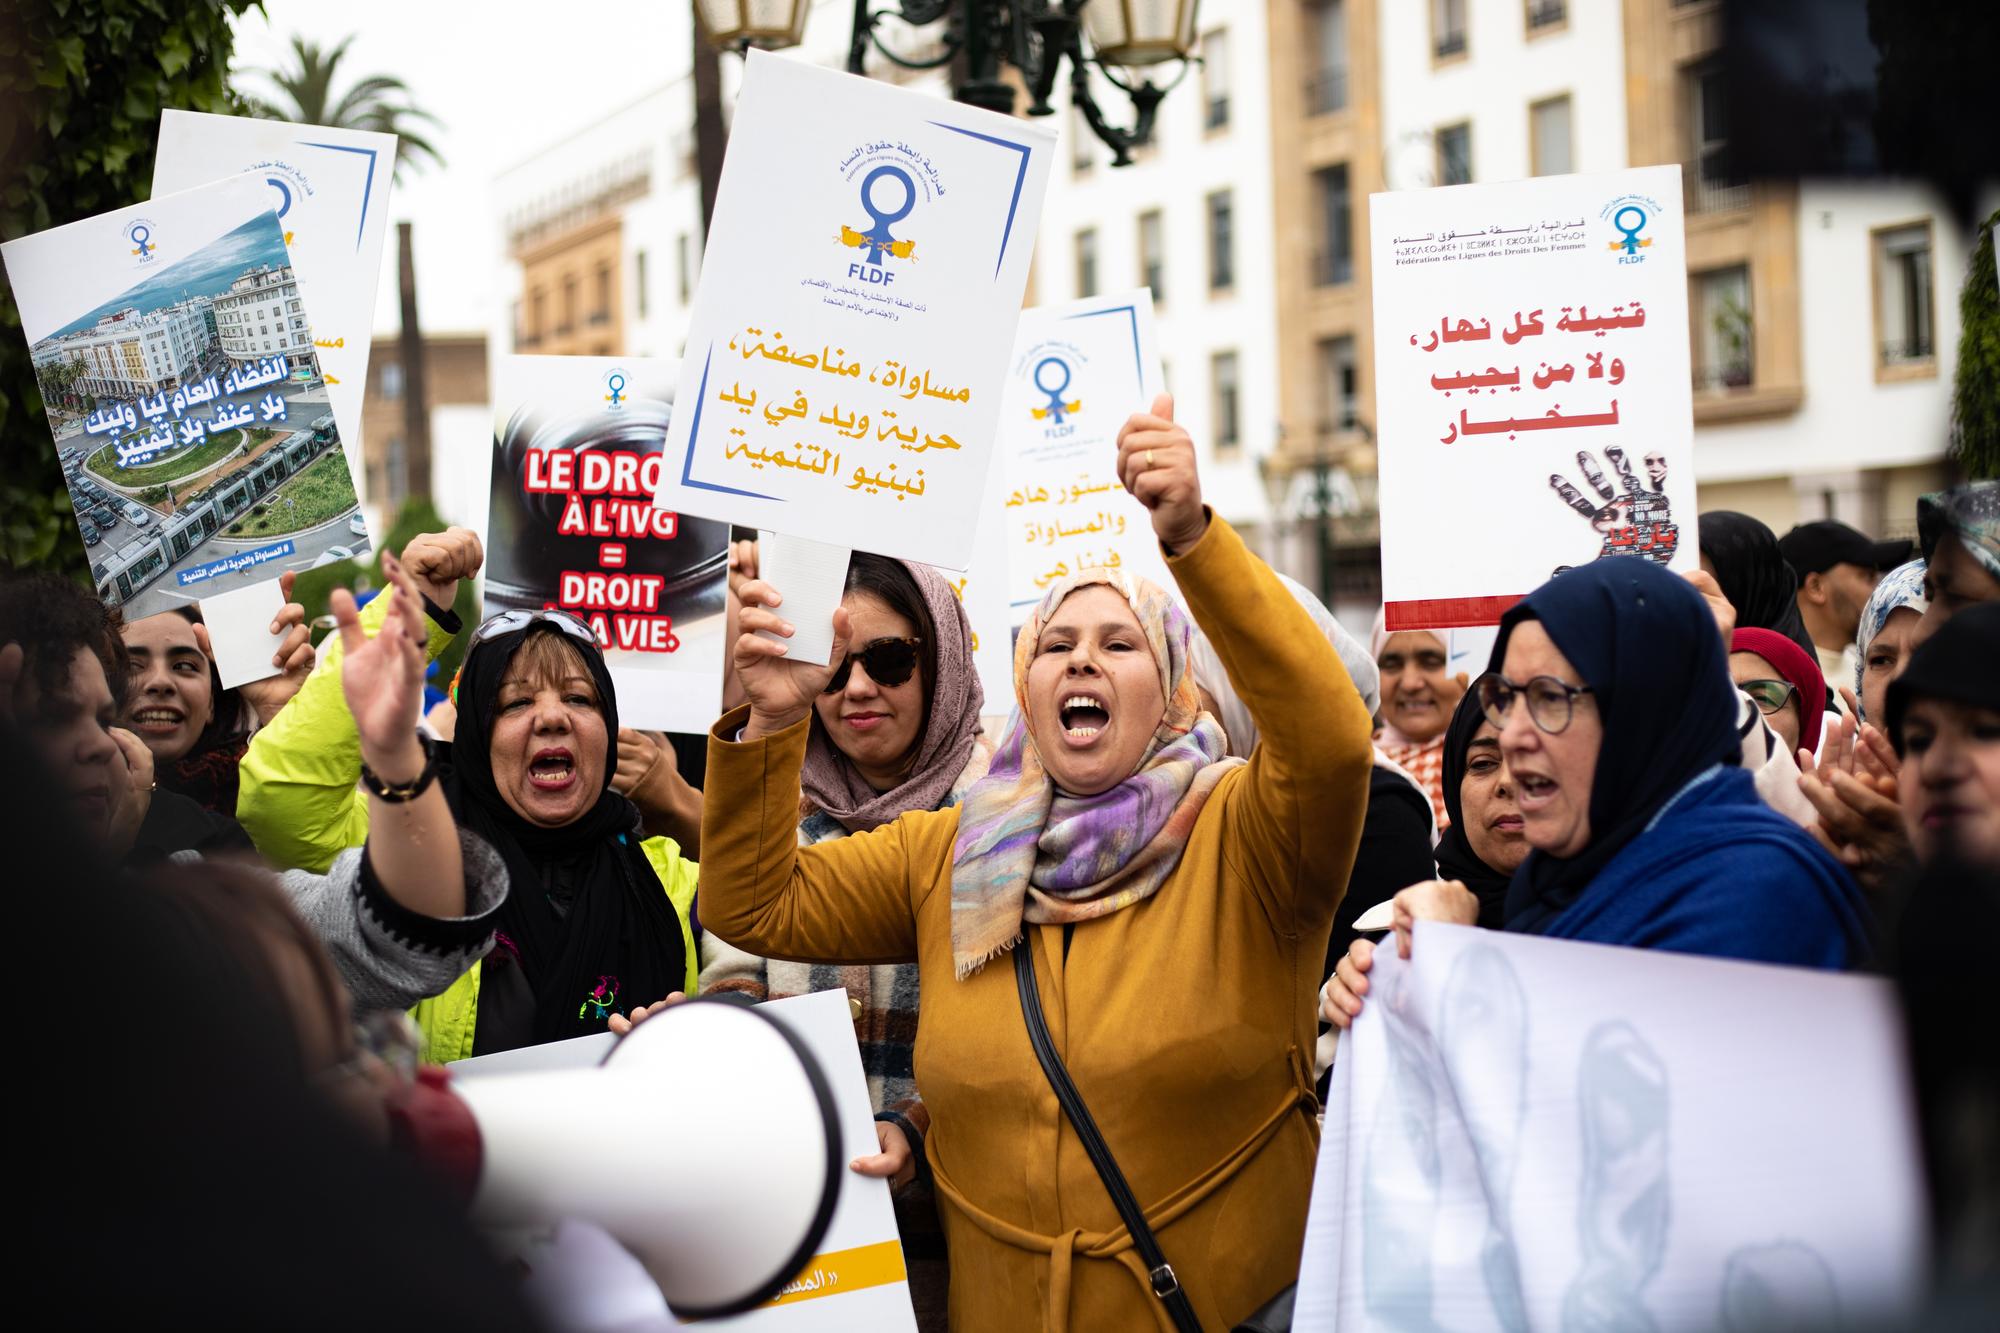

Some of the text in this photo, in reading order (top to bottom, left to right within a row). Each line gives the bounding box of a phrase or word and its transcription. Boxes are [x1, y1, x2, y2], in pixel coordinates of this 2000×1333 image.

[840, 147, 864, 172] النساء
[866, 140, 894, 155] حقوق
[896, 140, 922, 163] رابطة
[1396, 256, 1440, 266] Fédération
[1458, 252, 1486, 262] Ligues
[1504, 247, 1530, 256] Droits
[1551, 243, 1586, 252] Femmes
[1618, 255, 1646, 264] FLDF
[848, 263, 894, 286] FLDF
[1410, 301, 1646, 352] قتيلة كل نهار،
[728, 327, 970, 404] مساواة، مناصفة،
[1430, 351, 1626, 398] ولا من يجيب
[86, 354, 289, 436] الفضاء العام ليا وليك
[114, 394, 286, 467] بلا عنف بلا تمييز
[718, 380, 962, 453] حرية ويد في يد
[1044, 424, 1076, 438] FLDF
[1440, 398, 1620, 444] لخبار
[528, 453, 664, 492] LE DRO
[725, 427, 926, 502] نبنيو التنمية
[562, 496, 584, 532] À
[1634, 504, 1654, 512] STOP
[1634, 510, 1668, 521] NO MORE
[1024, 512, 1127, 546] والمساواة
[208, 560, 228, 577] أساس
[254, 546, 282, 562] المساواة
[182, 569, 208, 584] التنمية
[564, 577, 660, 608] DROIT
[618, 618, 675, 648] VIE.
